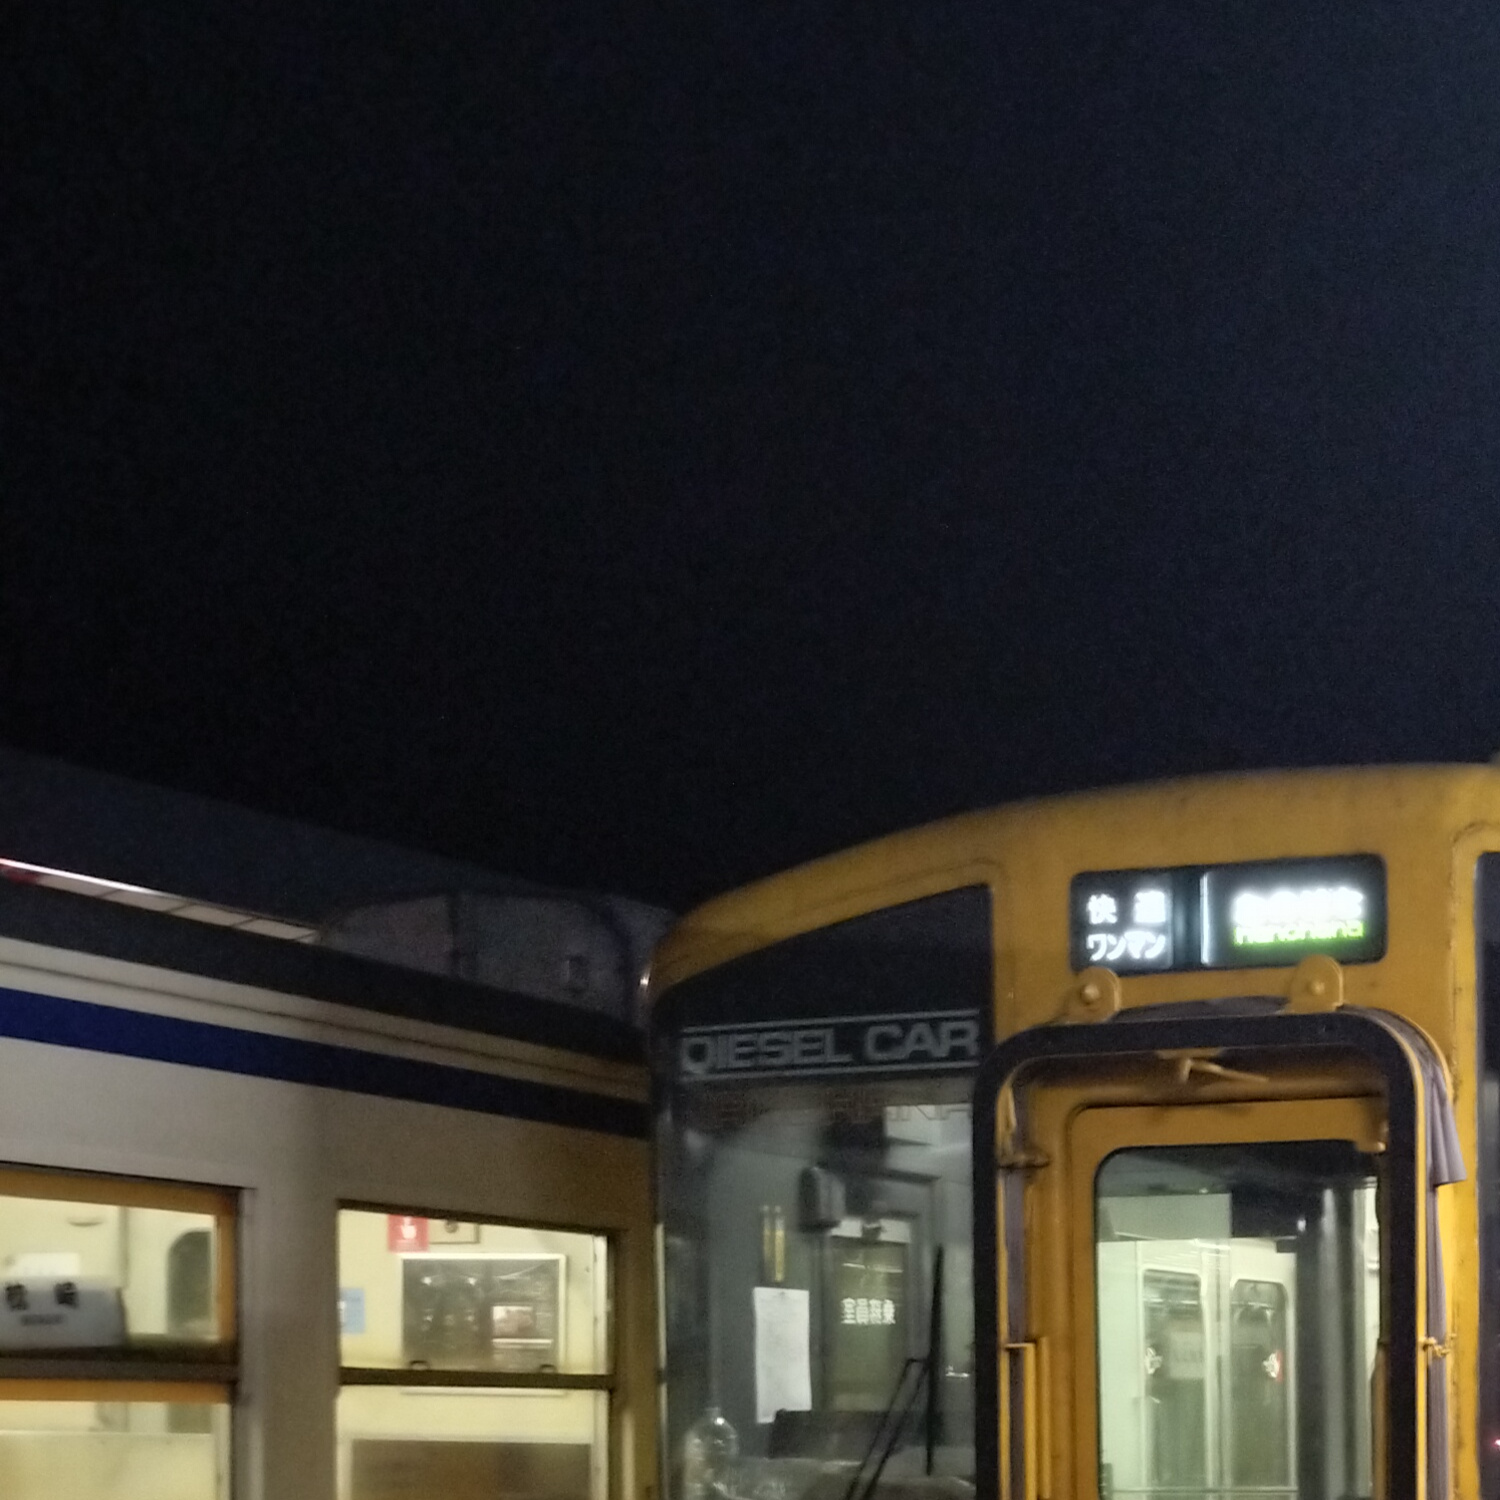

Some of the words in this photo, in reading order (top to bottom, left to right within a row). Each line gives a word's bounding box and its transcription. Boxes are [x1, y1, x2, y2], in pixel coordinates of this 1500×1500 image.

[1086, 930, 1168, 962] ワンマン
[681, 1027, 854, 1074] DIESEL
[863, 1017, 979, 1062] CAR
